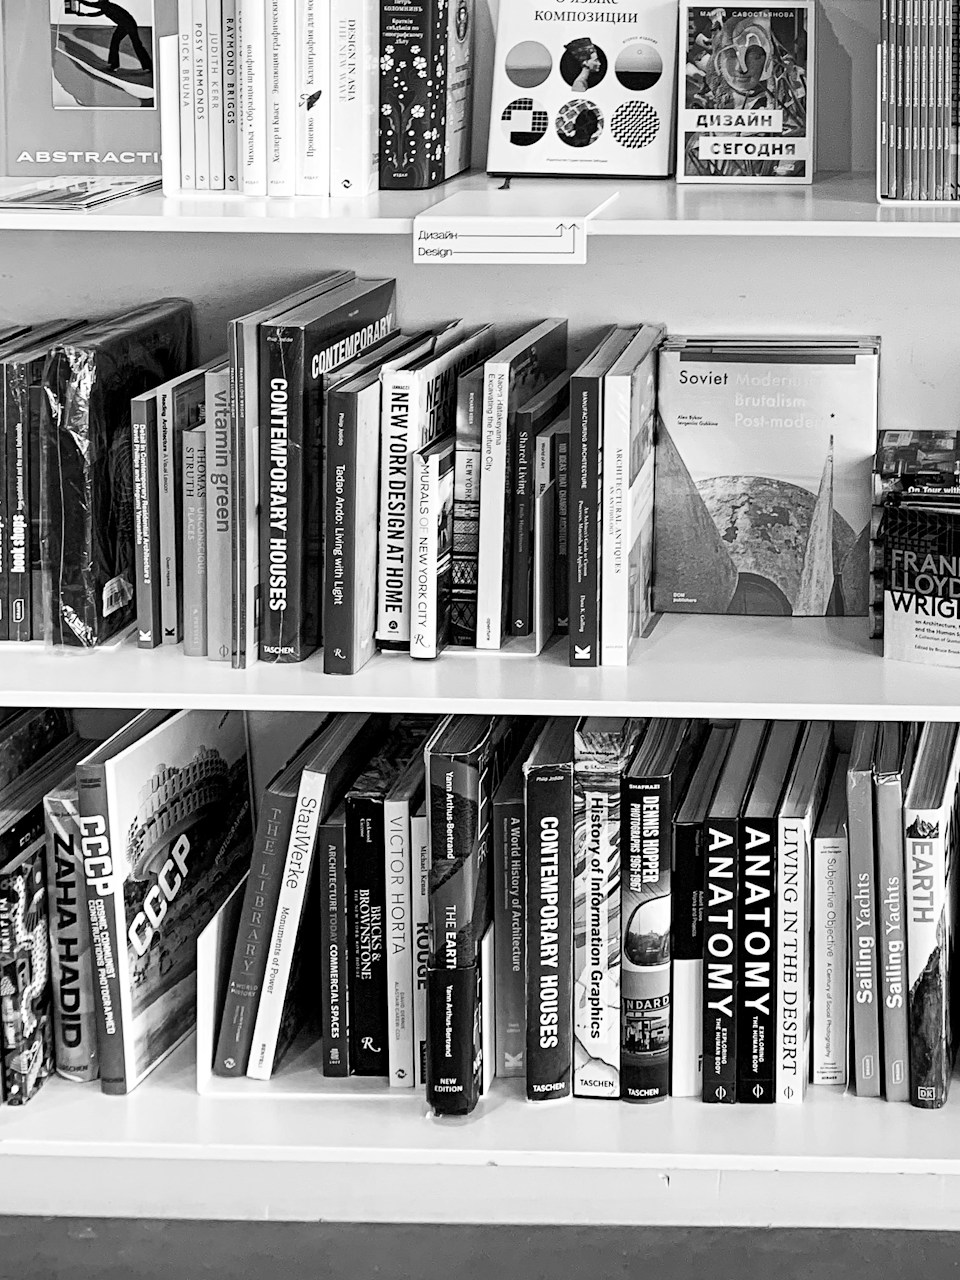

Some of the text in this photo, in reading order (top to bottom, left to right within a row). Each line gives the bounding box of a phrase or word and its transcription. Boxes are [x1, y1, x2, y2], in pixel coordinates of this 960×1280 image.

[226, 18, 235, 124] RAYMOND BRIGGS
[534, 10, 638, 25] композиции
[696, 114, 772, 128] ДИЗАЙН
[713, 142, 796, 157] СЕГОДНЯ
[417, 230, 458, 241] Дизайн
[417, 247, 454, 259] Design
[679, 369, 728, 385] Soviet
[210, 389, 232, 533] vitamin green
[269, 378, 289, 612] CONTEMPORARY HOUSES
[385, 392, 410, 614] NEW YORK DESIGN AT HOME
[331, 464, 346, 605] Tadao Ando: Living with Light
[417, 464, 430, 628] MURALS OF NEW YORK CITY
[286, 796, 317, 889] StauWerke
[390, 816, 406, 955] VICTOR HORTA
[642, 795, 660, 884] DENNIS HOPPER
[912, 840, 935, 924] EARTH
[52, 831, 83, 1049] ZAHA HADID
[539, 816, 559, 1049] CONTEMPORARY HOUSES
[589, 797, 606, 1039] History of Information Graphics
[707, 827, 734, 1017] ANATOMY
[744, 826, 771, 1016] ANATOMY
[782, 827, 798, 1076] LIVING IN THE DESERT
[854, 873, 873, 1004] Sailing Yachts
